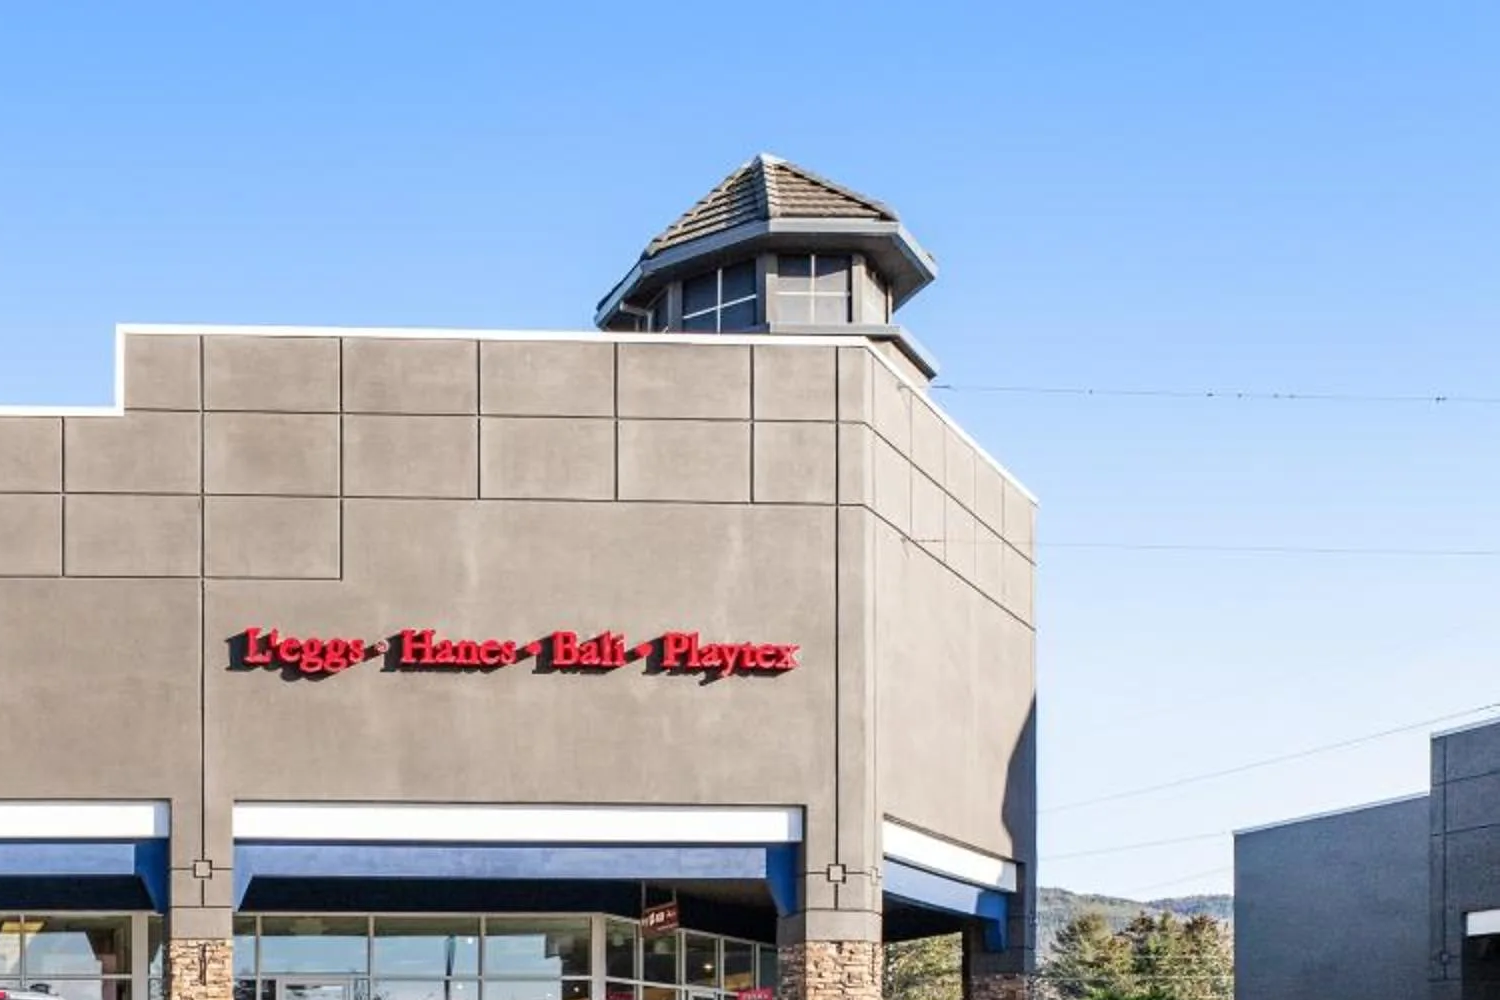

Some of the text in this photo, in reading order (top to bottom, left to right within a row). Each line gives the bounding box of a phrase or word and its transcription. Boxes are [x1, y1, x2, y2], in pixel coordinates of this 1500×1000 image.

[401, 628, 515, 664] Hanes
[552, 630, 627, 667] Bali
[663, 631, 800, 678] Playtex
